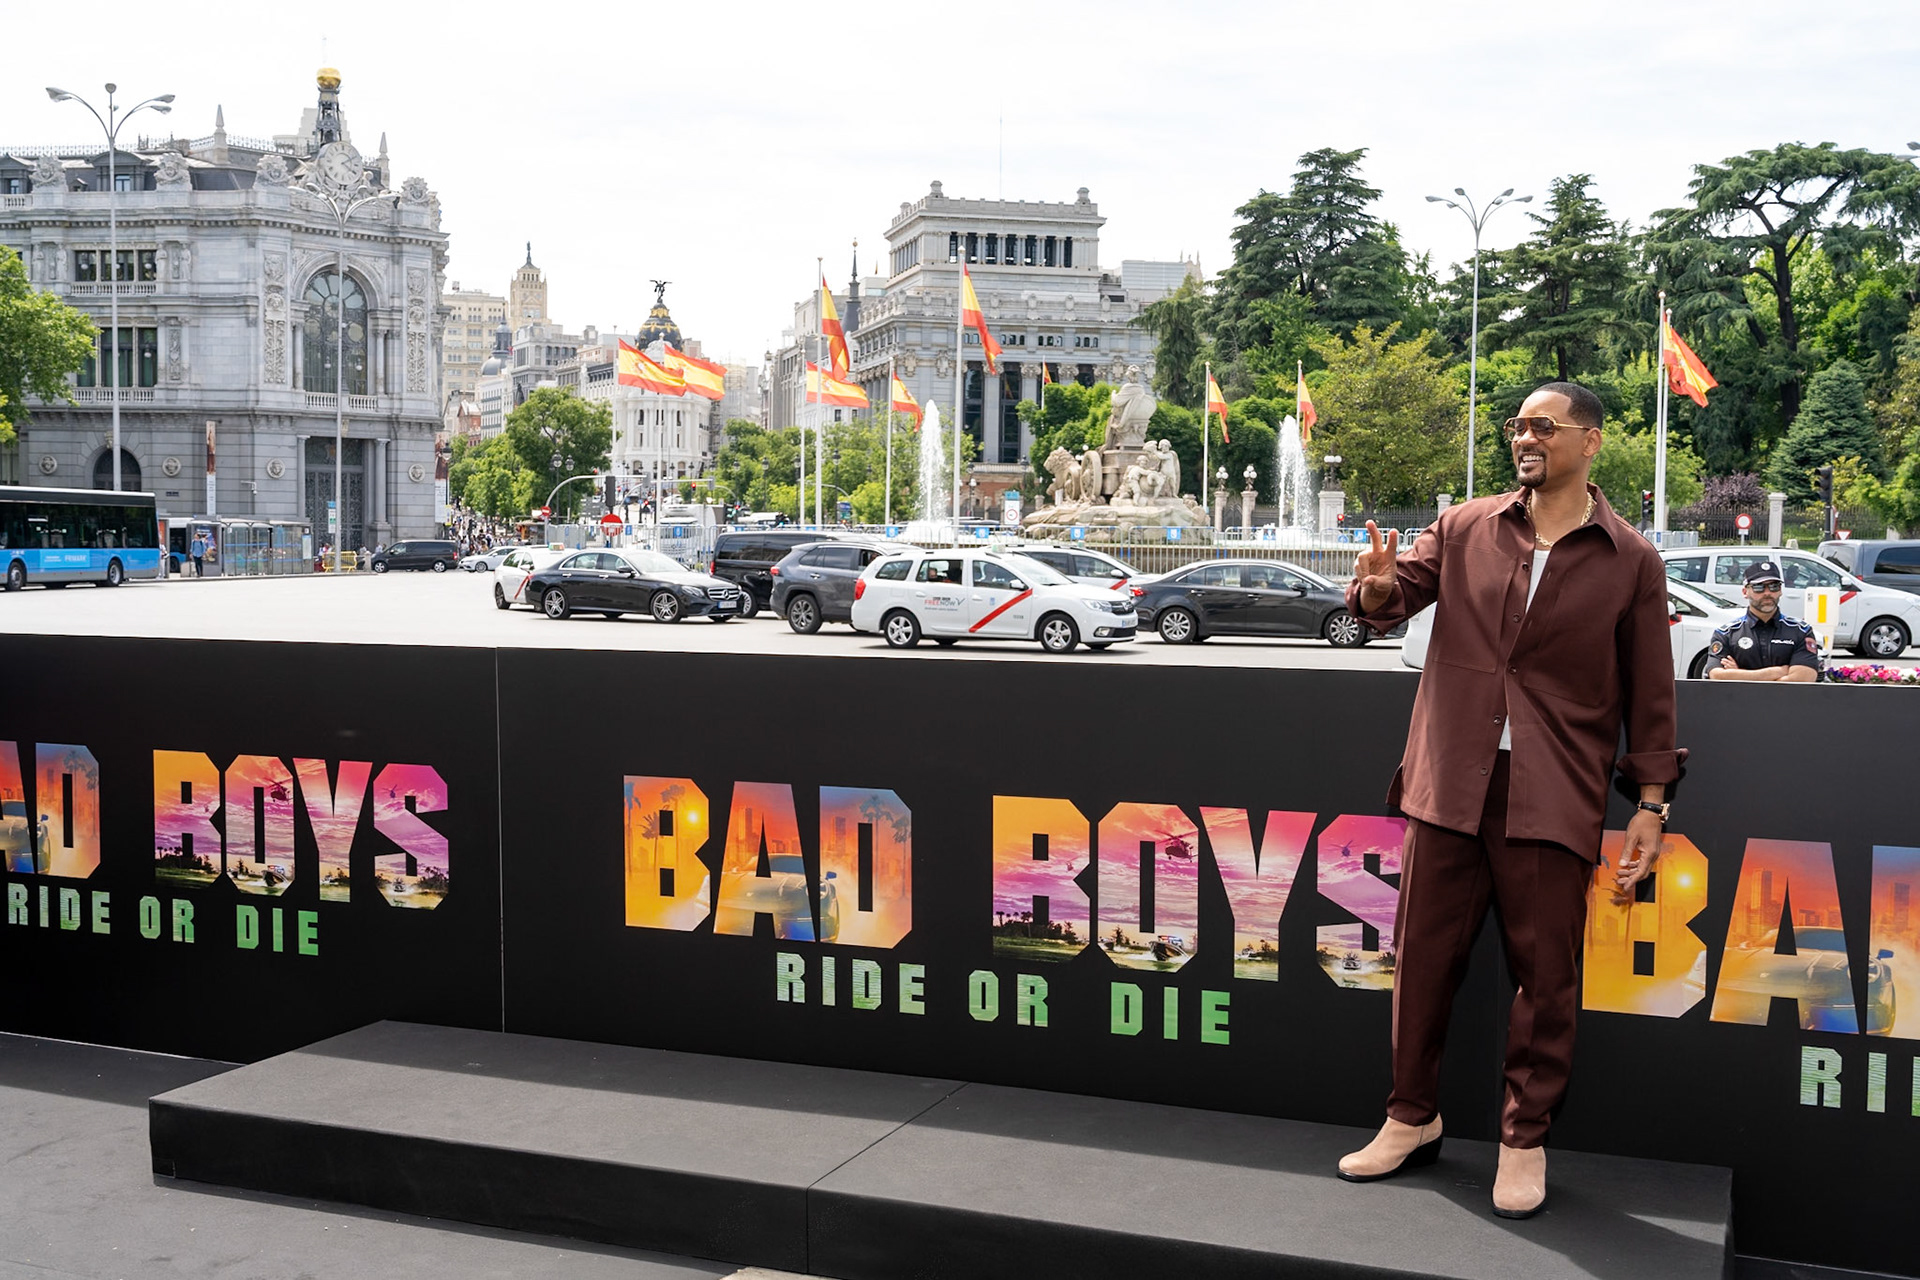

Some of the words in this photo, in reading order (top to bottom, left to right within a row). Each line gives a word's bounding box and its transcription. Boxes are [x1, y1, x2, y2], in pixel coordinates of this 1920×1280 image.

[153, 749, 449, 910] BOYS
[8, 882, 110, 935] RIDE
[139, 896, 195, 943] OR
[236, 904, 319, 956] DIE
[623, 774, 912, 949] BAD
[992, 795, 1409, 991] BOYS
[776, 951, 926, 1015] RIDE
[968, 970, 1049, 1028] OR
[1110, 981, 1231, 1046] DIE
[1800, 1046, 1920, 1116] RI
